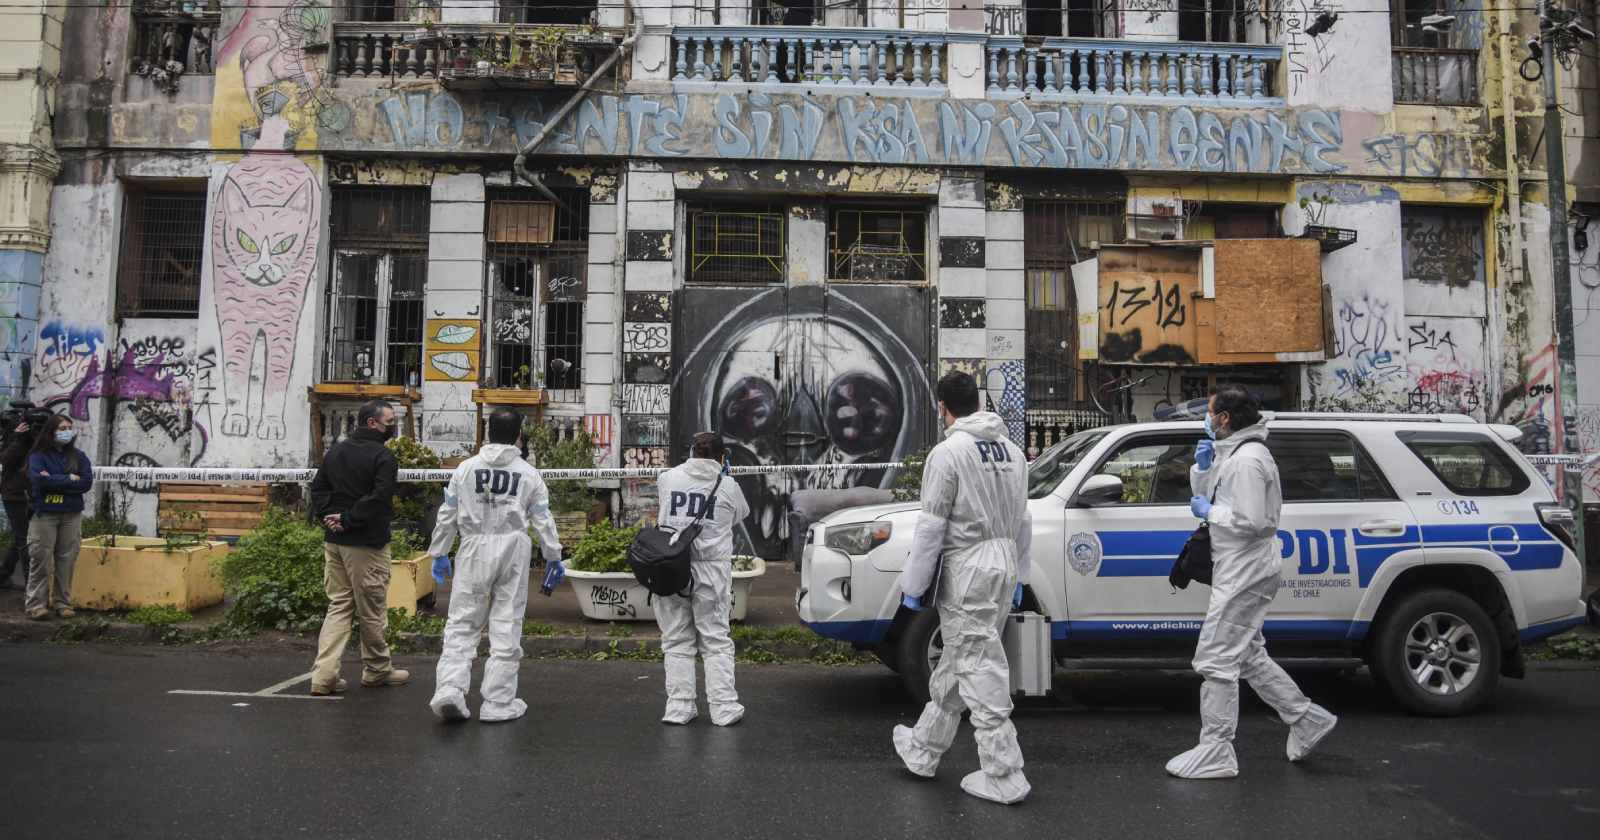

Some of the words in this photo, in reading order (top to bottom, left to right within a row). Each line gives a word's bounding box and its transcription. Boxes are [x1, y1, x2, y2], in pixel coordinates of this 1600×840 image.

[378, 93, 464, 147] NO
[1107, 279, 1186, 329] 1312
[975, 440, 1012, 463] PDI
[475, 468, 522, 496] PDI
[44, 494, 64, 503] PDI
[670, 491, 717, 520] PDI
[1452, 500, 1480, 515] 134
[1293, 589, 1301, 598] DE
[1303, 589, 1320, 598] CHILE
[1298, 578, 1351, 588] INVESTIGACIONES
